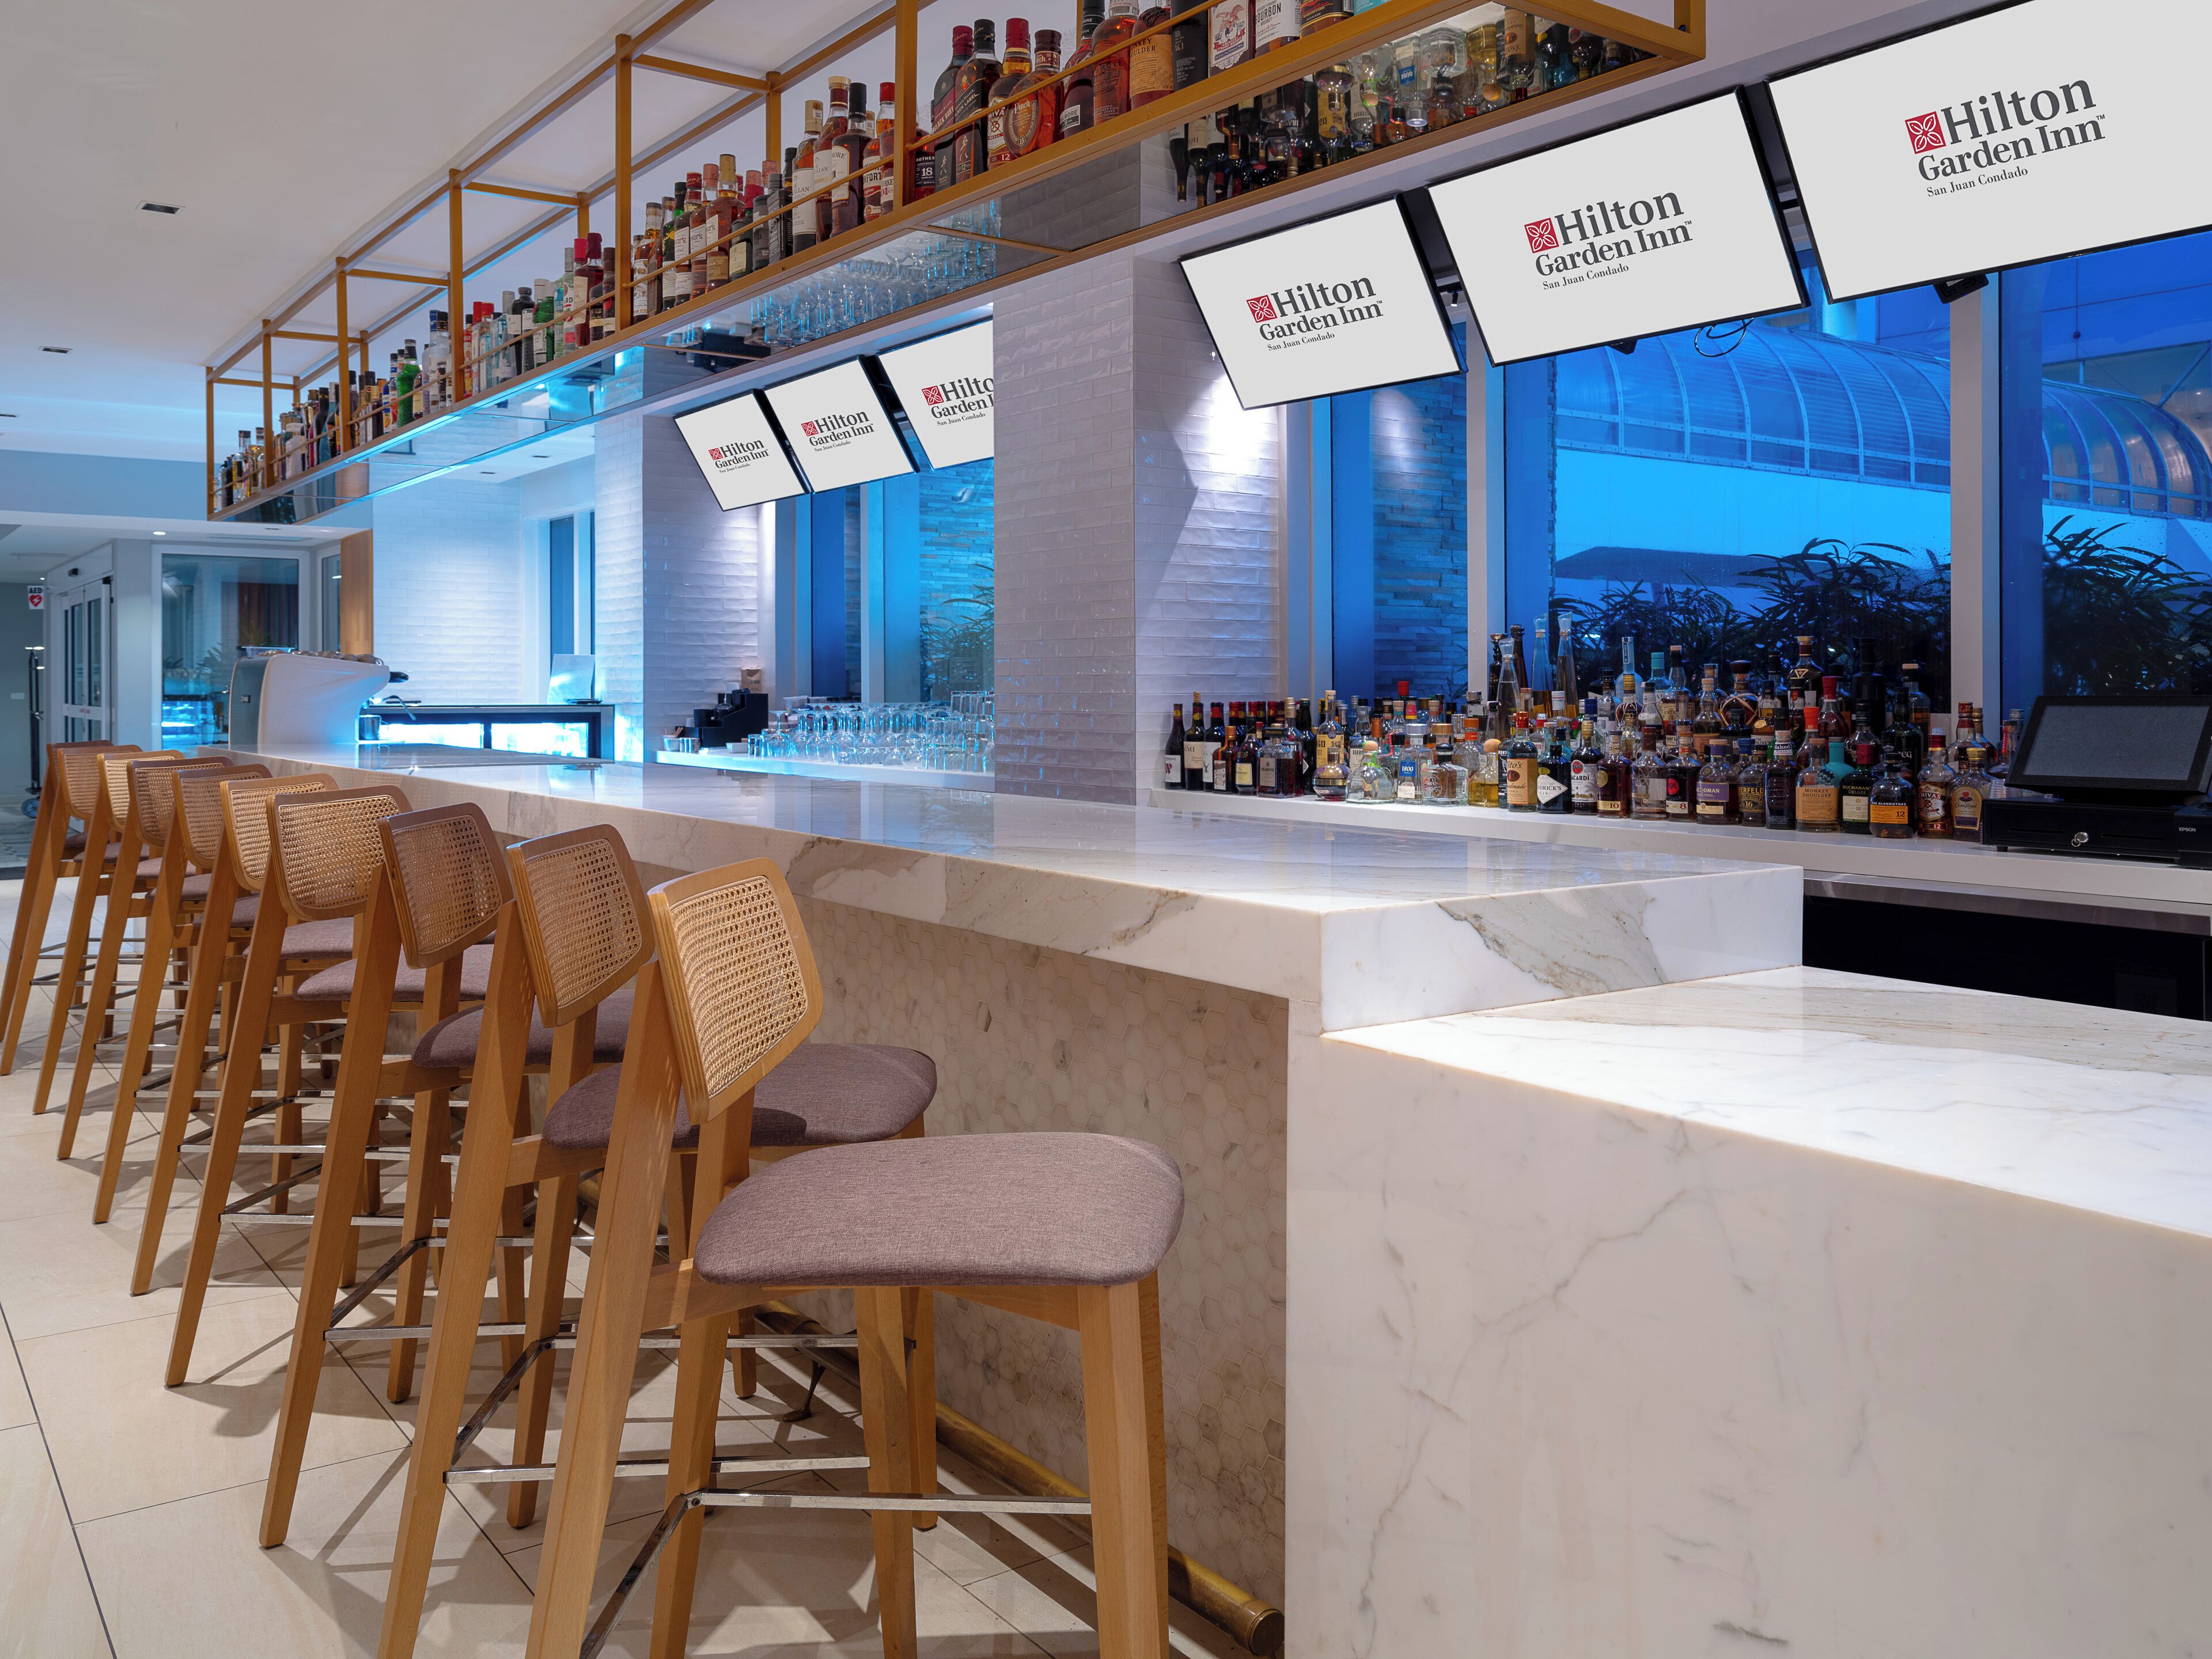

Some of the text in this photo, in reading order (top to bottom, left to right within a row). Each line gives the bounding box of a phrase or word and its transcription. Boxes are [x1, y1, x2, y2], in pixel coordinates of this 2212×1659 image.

[1255, 3, 1282, 25] BOURBON
[1260, 18, 1272, 26] WHISKEY
[1130, 37, 1153, 51] ONKEY
[1130, 45, 1156, 58] OULDER
[956, 106, 964, 116] LACK
[989, 108, 1004, 119] HIVA
[1014, 99, 1031, 114] Pinch
[1060, 109, 1078, 121] ALMORE
[1941, 79, 2096, 145] Hilton
[1001, 153, 1010, 161] 12
[1918, 119, 2105, 181] Garden Inn
[921, 167, 933, 176] 18
[793, 186, 810, 194] ALLAN
[881, 179, 893, 187] URKE
[1926, 166, 2028, 197] San Juan Condado
[1555, 192, 1684, 245] Hilton
[1535, 223, 1693, 276] Garden Inn
[1542, 263, 1629, 290] San Juan Condado
[1271, 276, 1376, 317] Hilton
[1259, 302, 1384, 340] Garden Inn
[1283, 340, 1301, 349] Juan
[1301, 331, 1335, 344] Condado
[940, 377, 994, 402] Hilto
[931, 399, 988, 419] Garden
[961, 412, 986, 421] Condado
[815, 411, 870, 433] Hilton
[809, 424, 875, 447] Garden Inn
[833, 440, 851, 449] Condado
[719, 440, 765, 459] Hilton
[715, 449, 770, 469] Garden Inn
[1738, 786, 1764, 794] BERFELD
